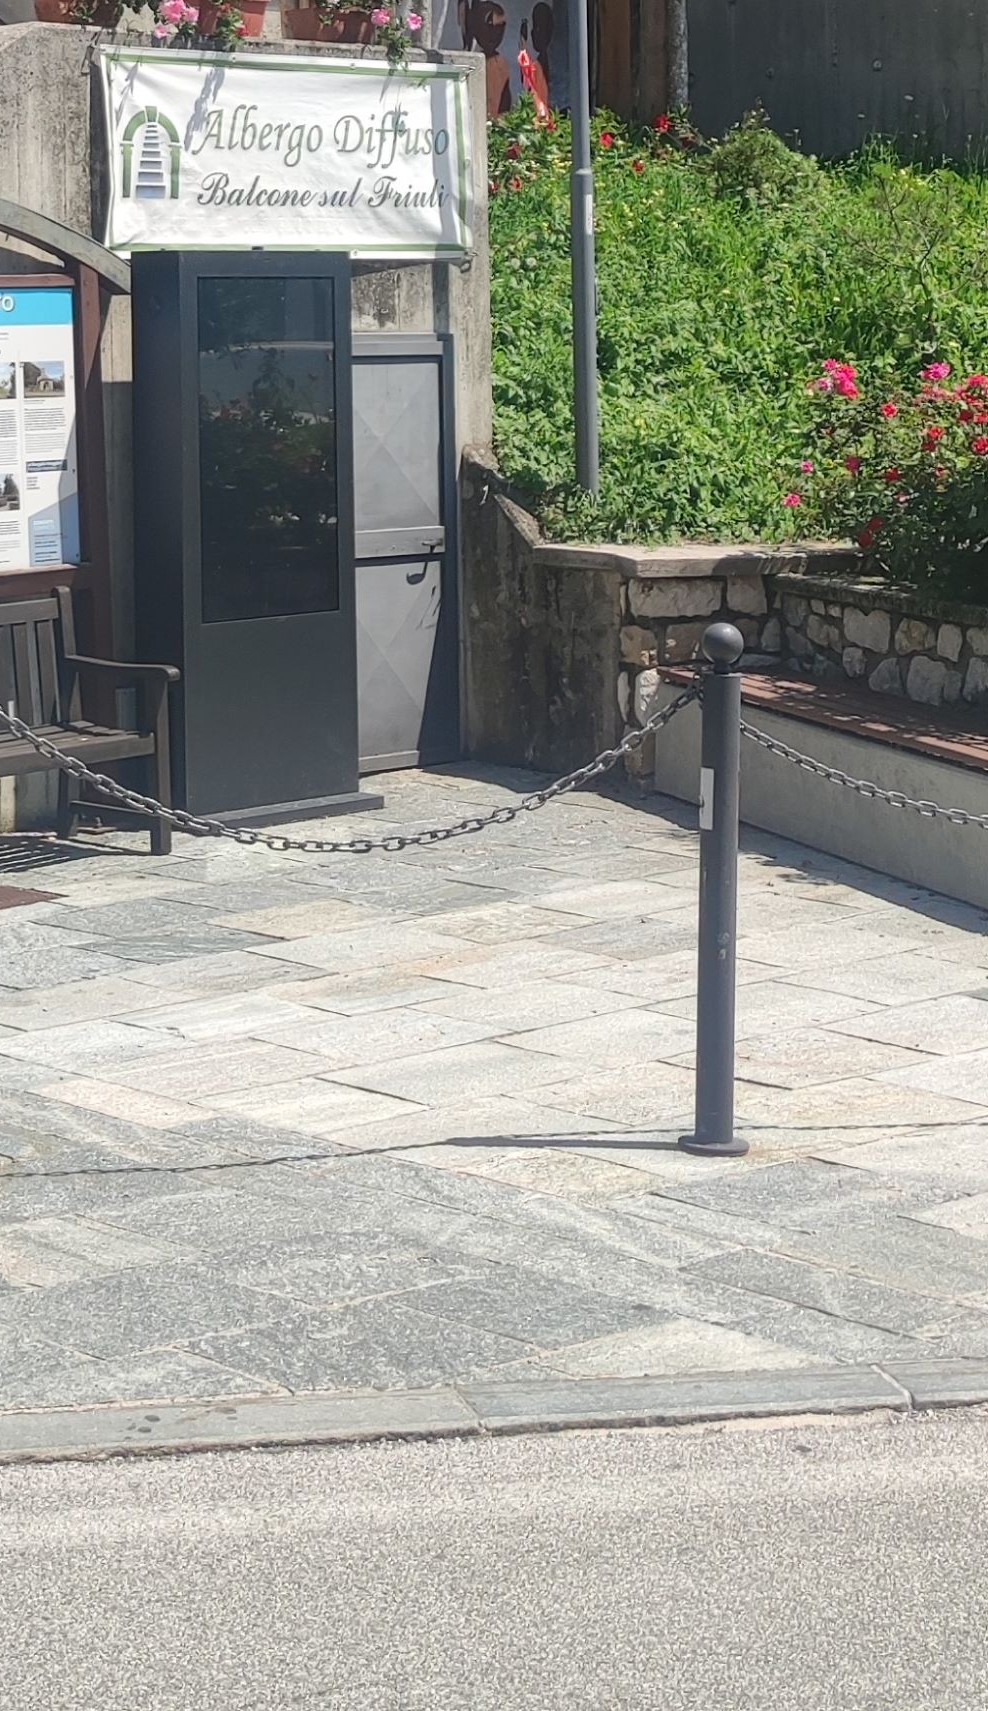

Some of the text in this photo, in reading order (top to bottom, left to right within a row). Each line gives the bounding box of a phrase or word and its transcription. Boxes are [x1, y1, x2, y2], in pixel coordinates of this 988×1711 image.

[193, 104, 450, 169] Albergo Diffuso
[197, 171, 450, 208] Balcone sul Friuli
